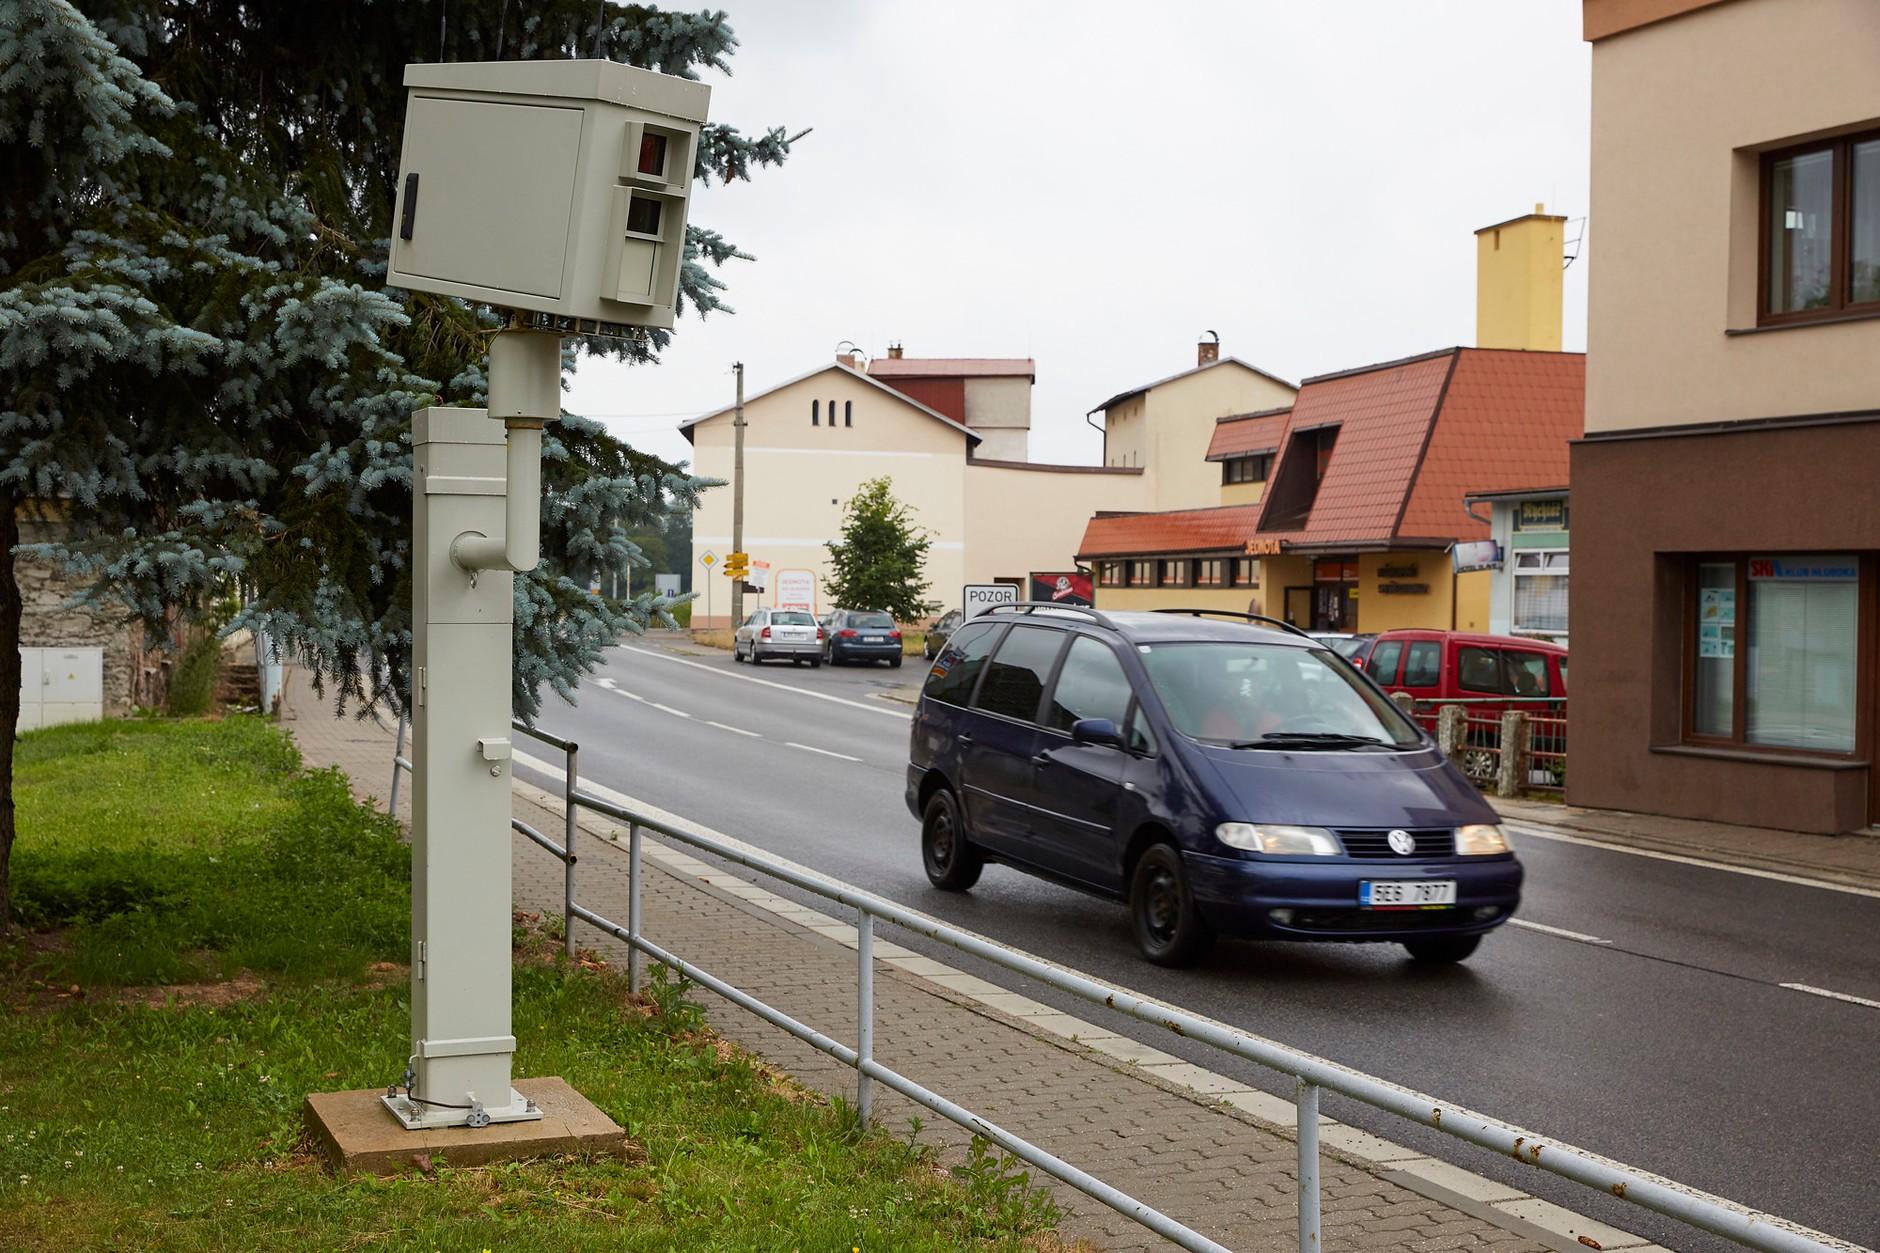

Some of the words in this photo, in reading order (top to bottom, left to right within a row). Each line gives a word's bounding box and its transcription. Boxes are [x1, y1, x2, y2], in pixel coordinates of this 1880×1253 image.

[1244, 539, 1281, 556] JEDNOTA
[1751, 559, 1774, 578] SKI
[1785, 567, 1808, 577] KLUB
[969, 590, 1012, 603] POZOR
